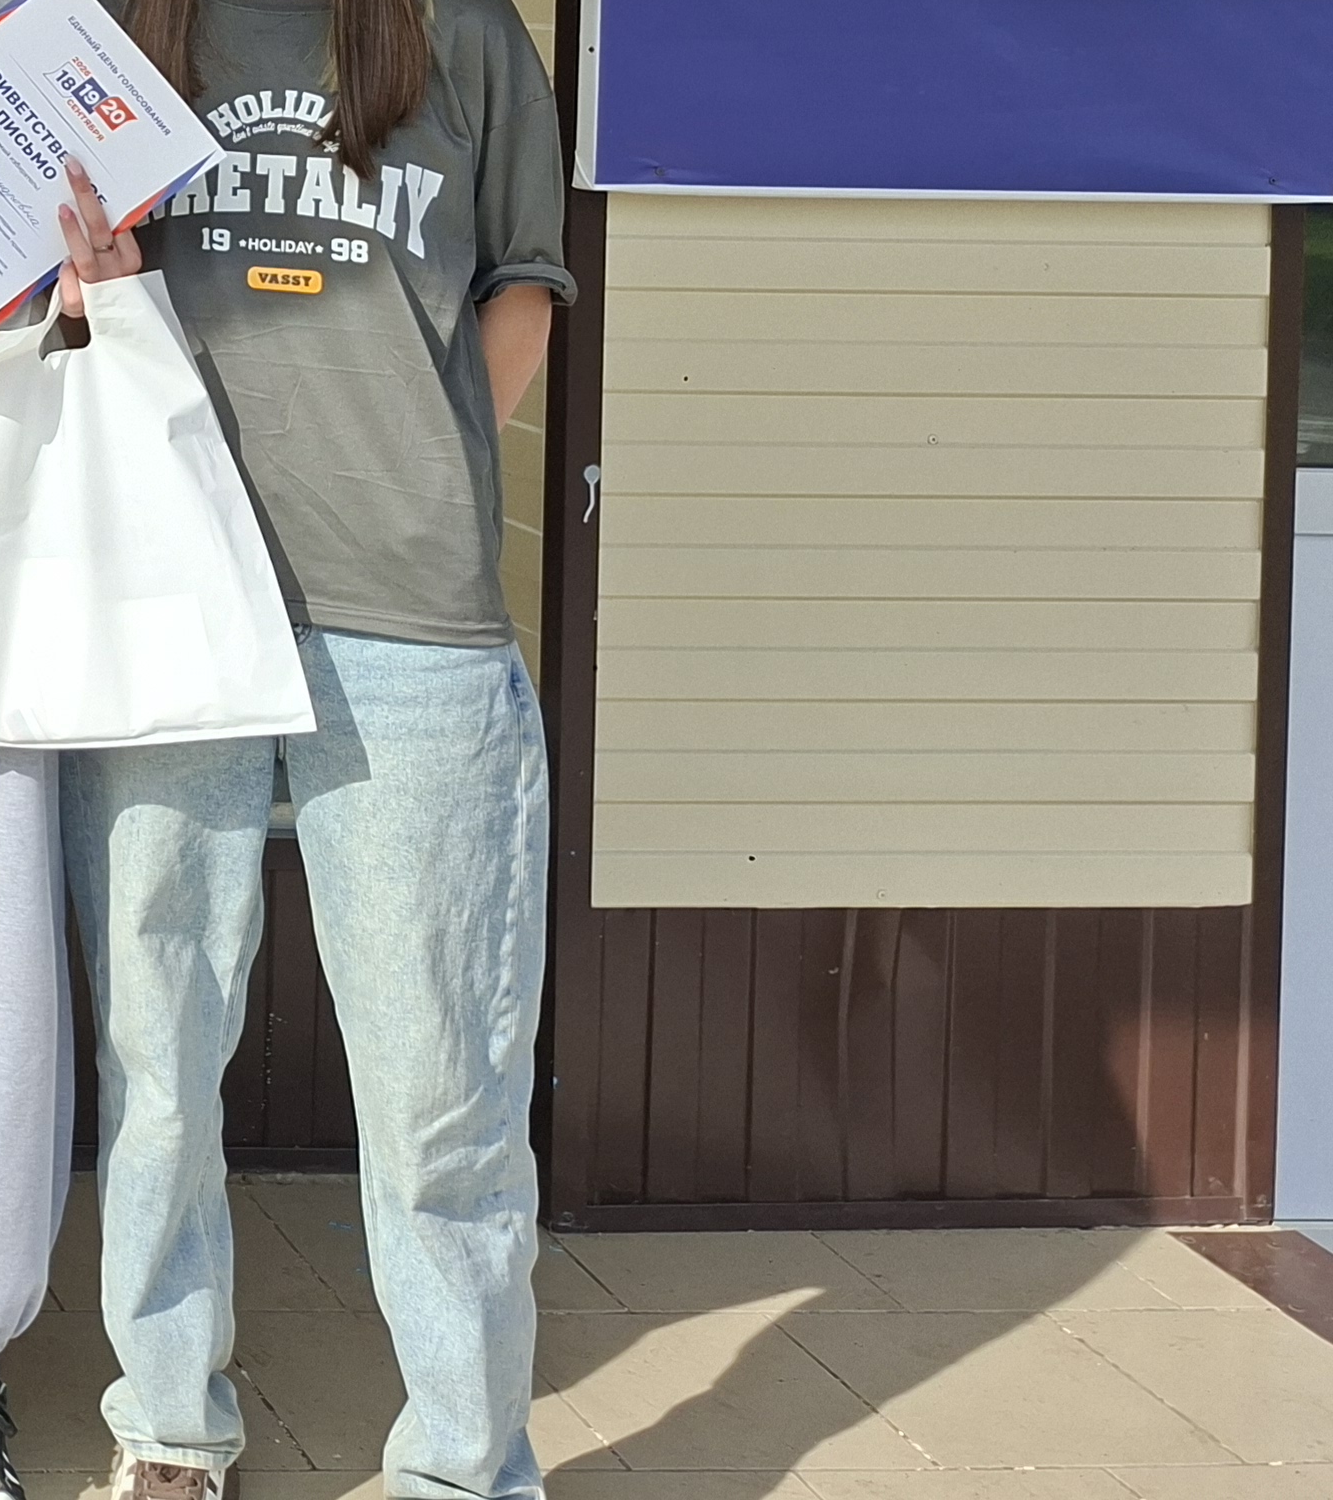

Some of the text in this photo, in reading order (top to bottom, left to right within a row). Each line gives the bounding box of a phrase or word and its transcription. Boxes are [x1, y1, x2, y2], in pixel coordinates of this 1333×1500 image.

[54, 68, 127, 126] 18 19 20
[67, 14, 172, 136] ЕДИНЫЙ ДЕНЬ ГОЛОСОВАНИЯ
[65, 97, 105, 142] СЕНТЯБРЯ
[206, 90, 340, 138] HOLID
[201, 227, 369, 264] 19 HOLIDAY 98
[258, 272, 312, 287] VASSY
